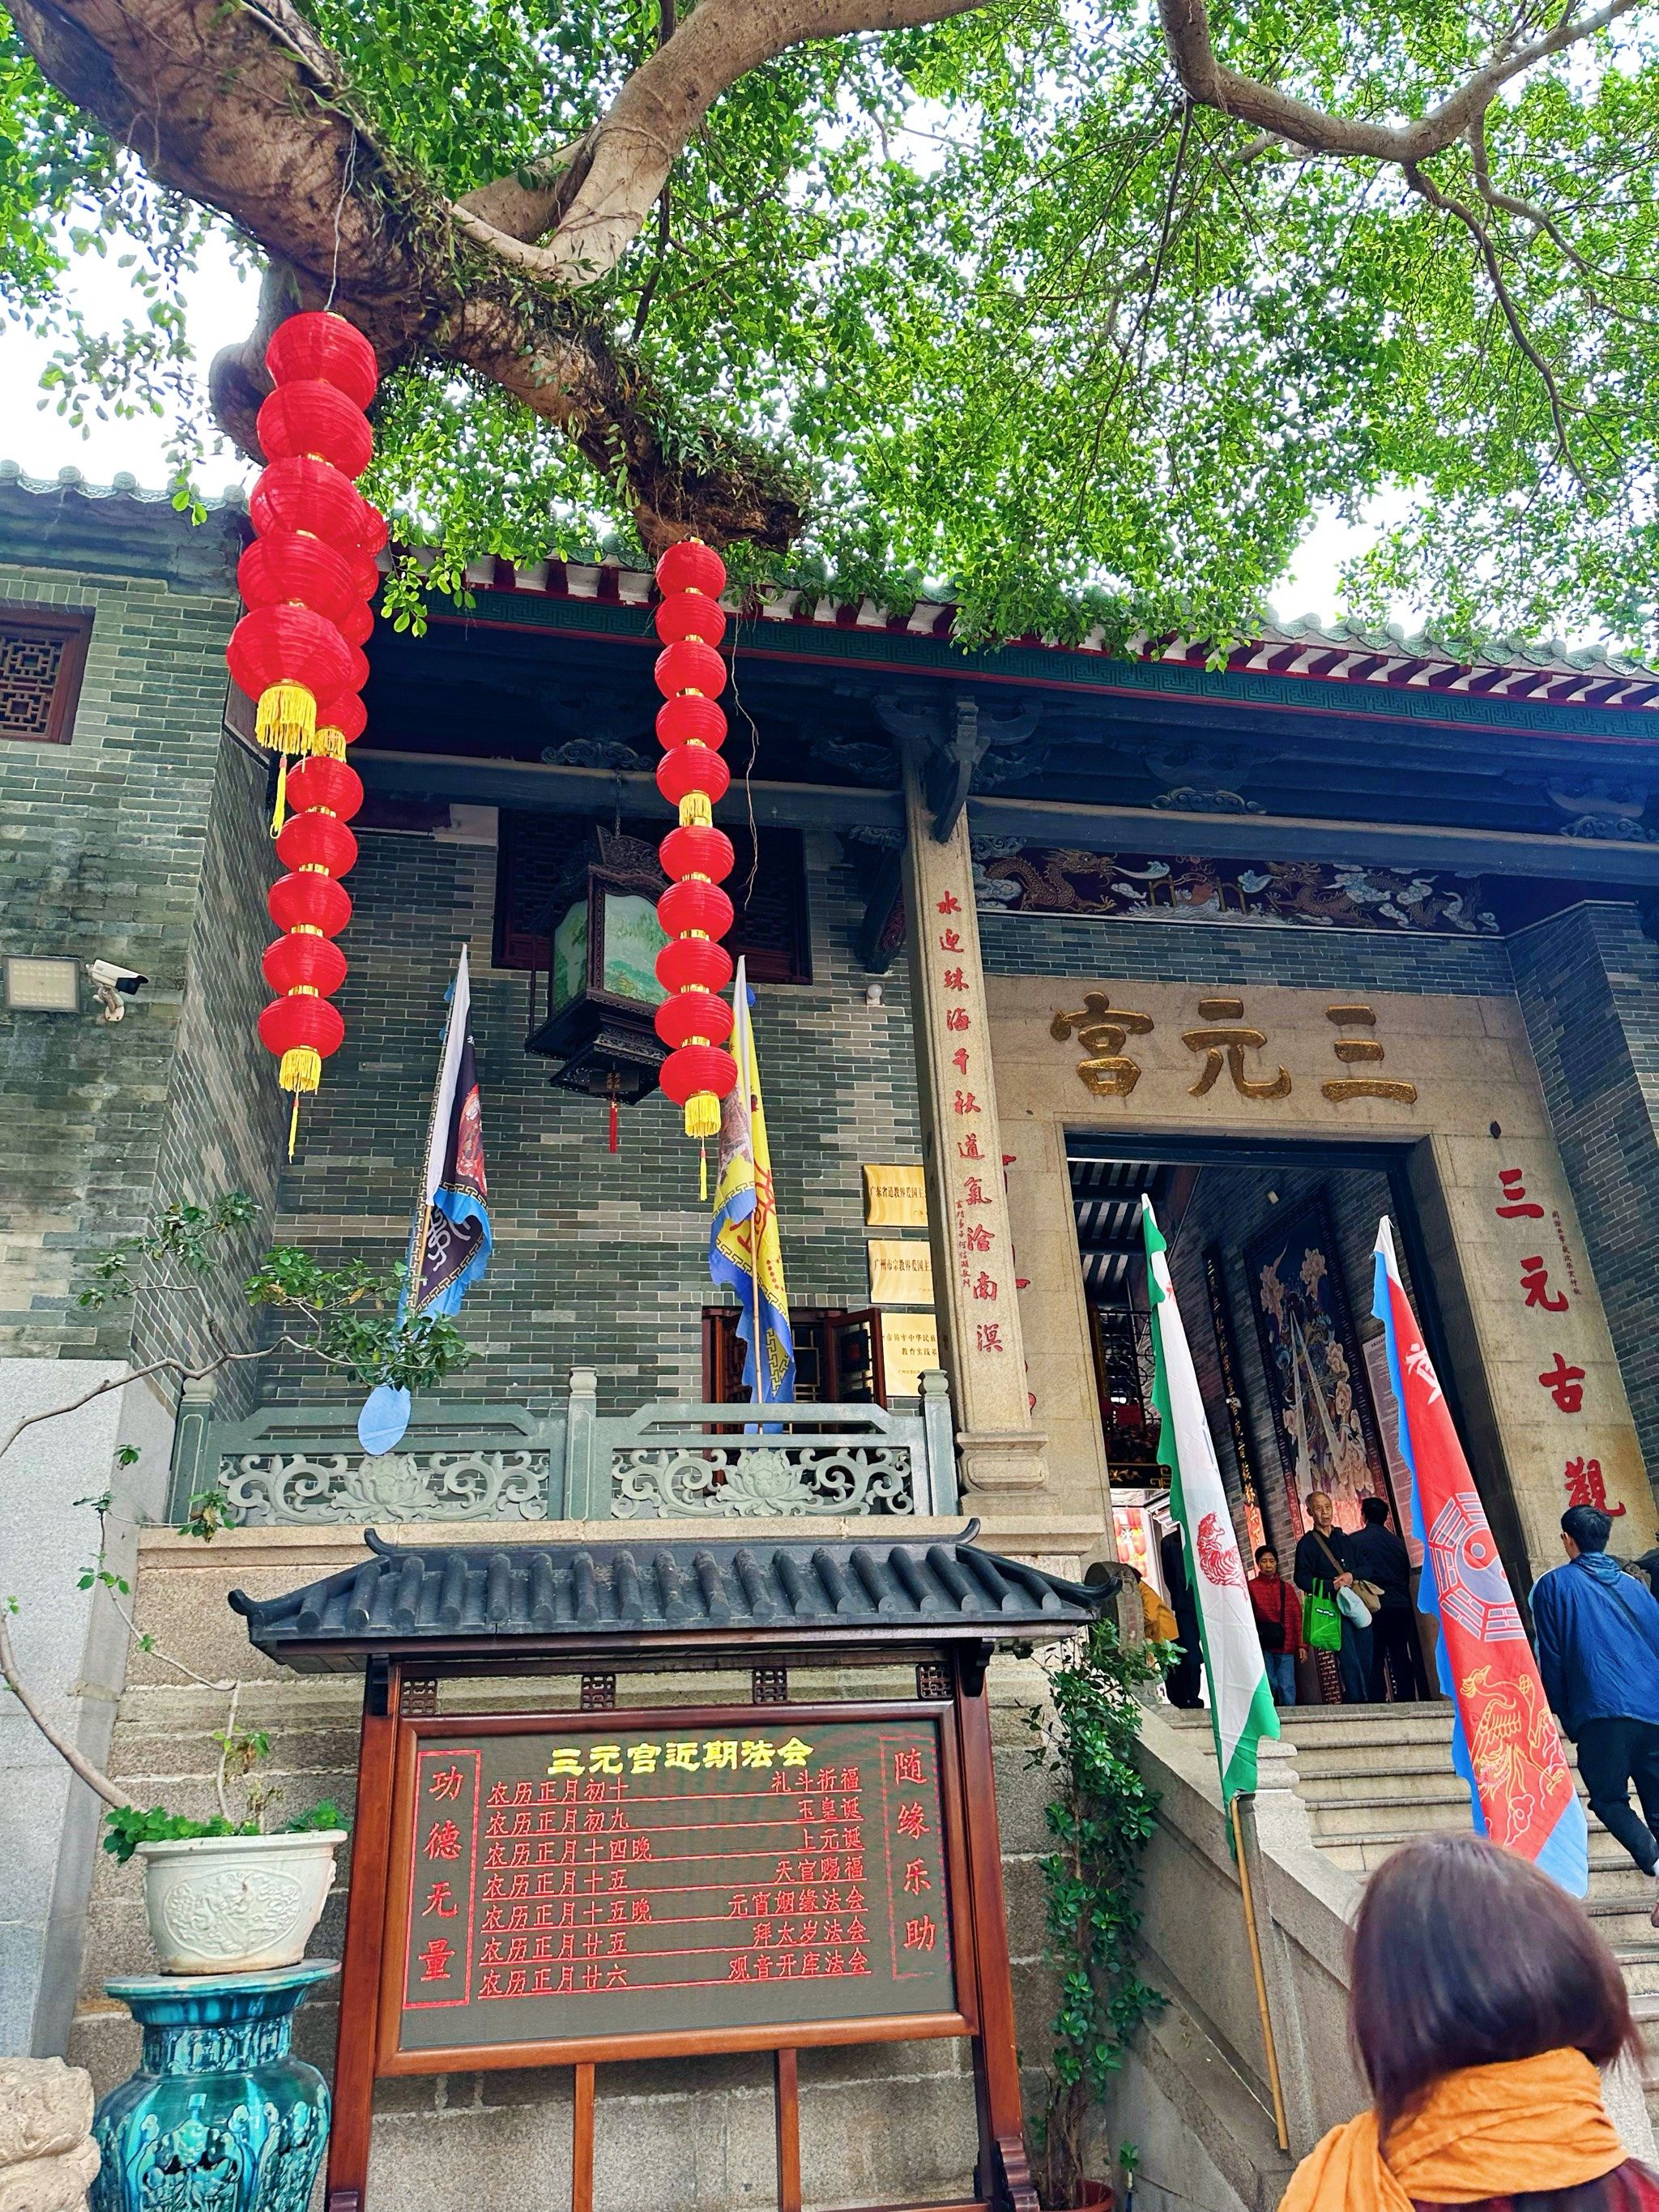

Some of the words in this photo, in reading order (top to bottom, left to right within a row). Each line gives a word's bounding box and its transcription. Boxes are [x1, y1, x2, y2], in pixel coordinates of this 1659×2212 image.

[870, 1185, 926, 1198] 广东省道教界爱国主
[873, 1258, 932, 1272] 广州市宗教界爱国主
[882, 1333, 936, 1342] 市铸牢中华民族
[547, 1737, 813, 1775] 三元宫近期法会
[488, 1777, 629, 1804] 农历正月初十
[771, 1766, 859, 1792] 礼斗祈福
[487, 1807, 629, 1835] 农历正月初九
[796, 1796, 862, 1821] 玉皇诞
[485, 1836, 652, 1866] 农历正月十四晚
[797, 1826, 863, 1851] 上元诞
[895, 1748, 936, 1951] 随缘乐助
[418, 1766, 463, 1982] 功德无量
[484, 1869, 628, 1898] 农历正月十五
[774, 1855, 863, 1884] 天官赐福
[482, 1898, 652, 1928] 农历正月十五晚
[728, 1885, 864, 1917] 元宵姻缘法会
[481, 1932, 627, 1962] 农历正月廿五
[753, 1915, 866, 1947] 拜太岁法会
[480, 1963, 627, 1996] 农历正月廿六
[729, 1947, 868, 1979] 观音开库法会
